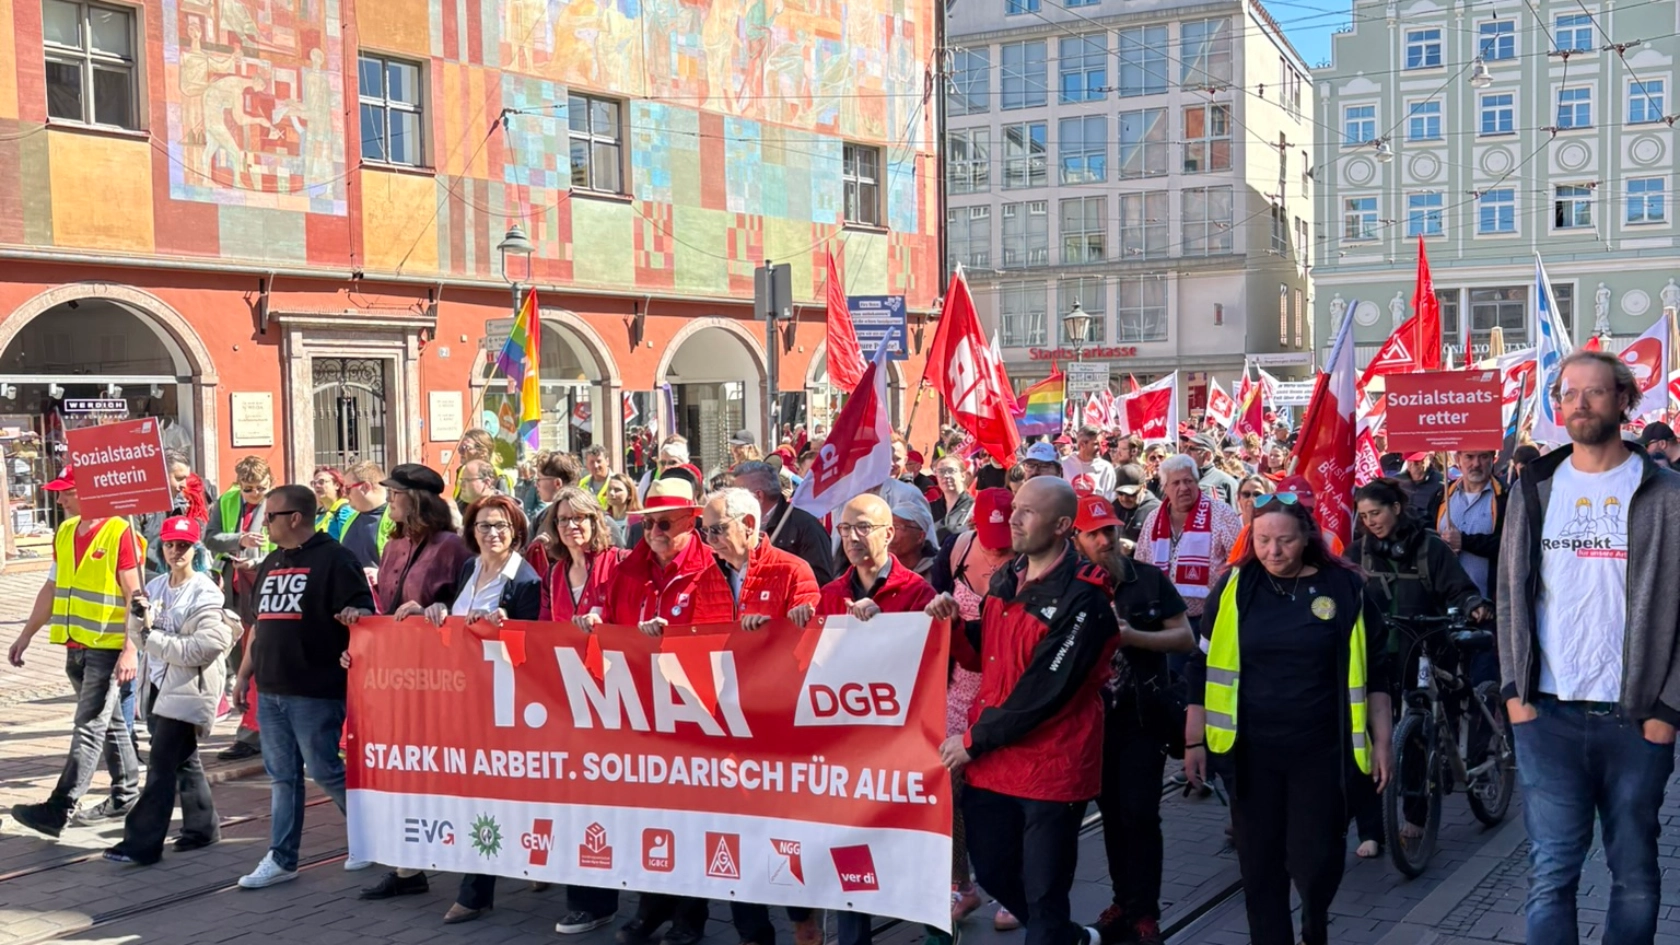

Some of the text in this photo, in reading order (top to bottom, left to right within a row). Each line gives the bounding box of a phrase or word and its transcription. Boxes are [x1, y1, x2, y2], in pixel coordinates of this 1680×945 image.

[1388, 389, 1500, 407] Sozialstaats-
[1418, 410, 1470, 426] retter
[72, 442, 160, 467] Sozialstaats-
[93, 466, 147, 488] retterin
[1541, 537, 1612, 551] Respekt
[259, 573, 308, 595] EVG
[258, 593, 303, 613] AUX
[363, 668, 467, 692] AUGSBURG
[481, 639, 753, 738] 1. MAI
[808, 682, 901, 718] DGB
[364, 742, 938, 805] STARK IN ARBEIT. SOLIDARISCH FÜR ALLE.
[404, 818, 455, 846] EVG
[520, 832, 555, 852] GEW
[779, 841, 801, 855] NGG
[841, 872, 875, 885] ver.di
